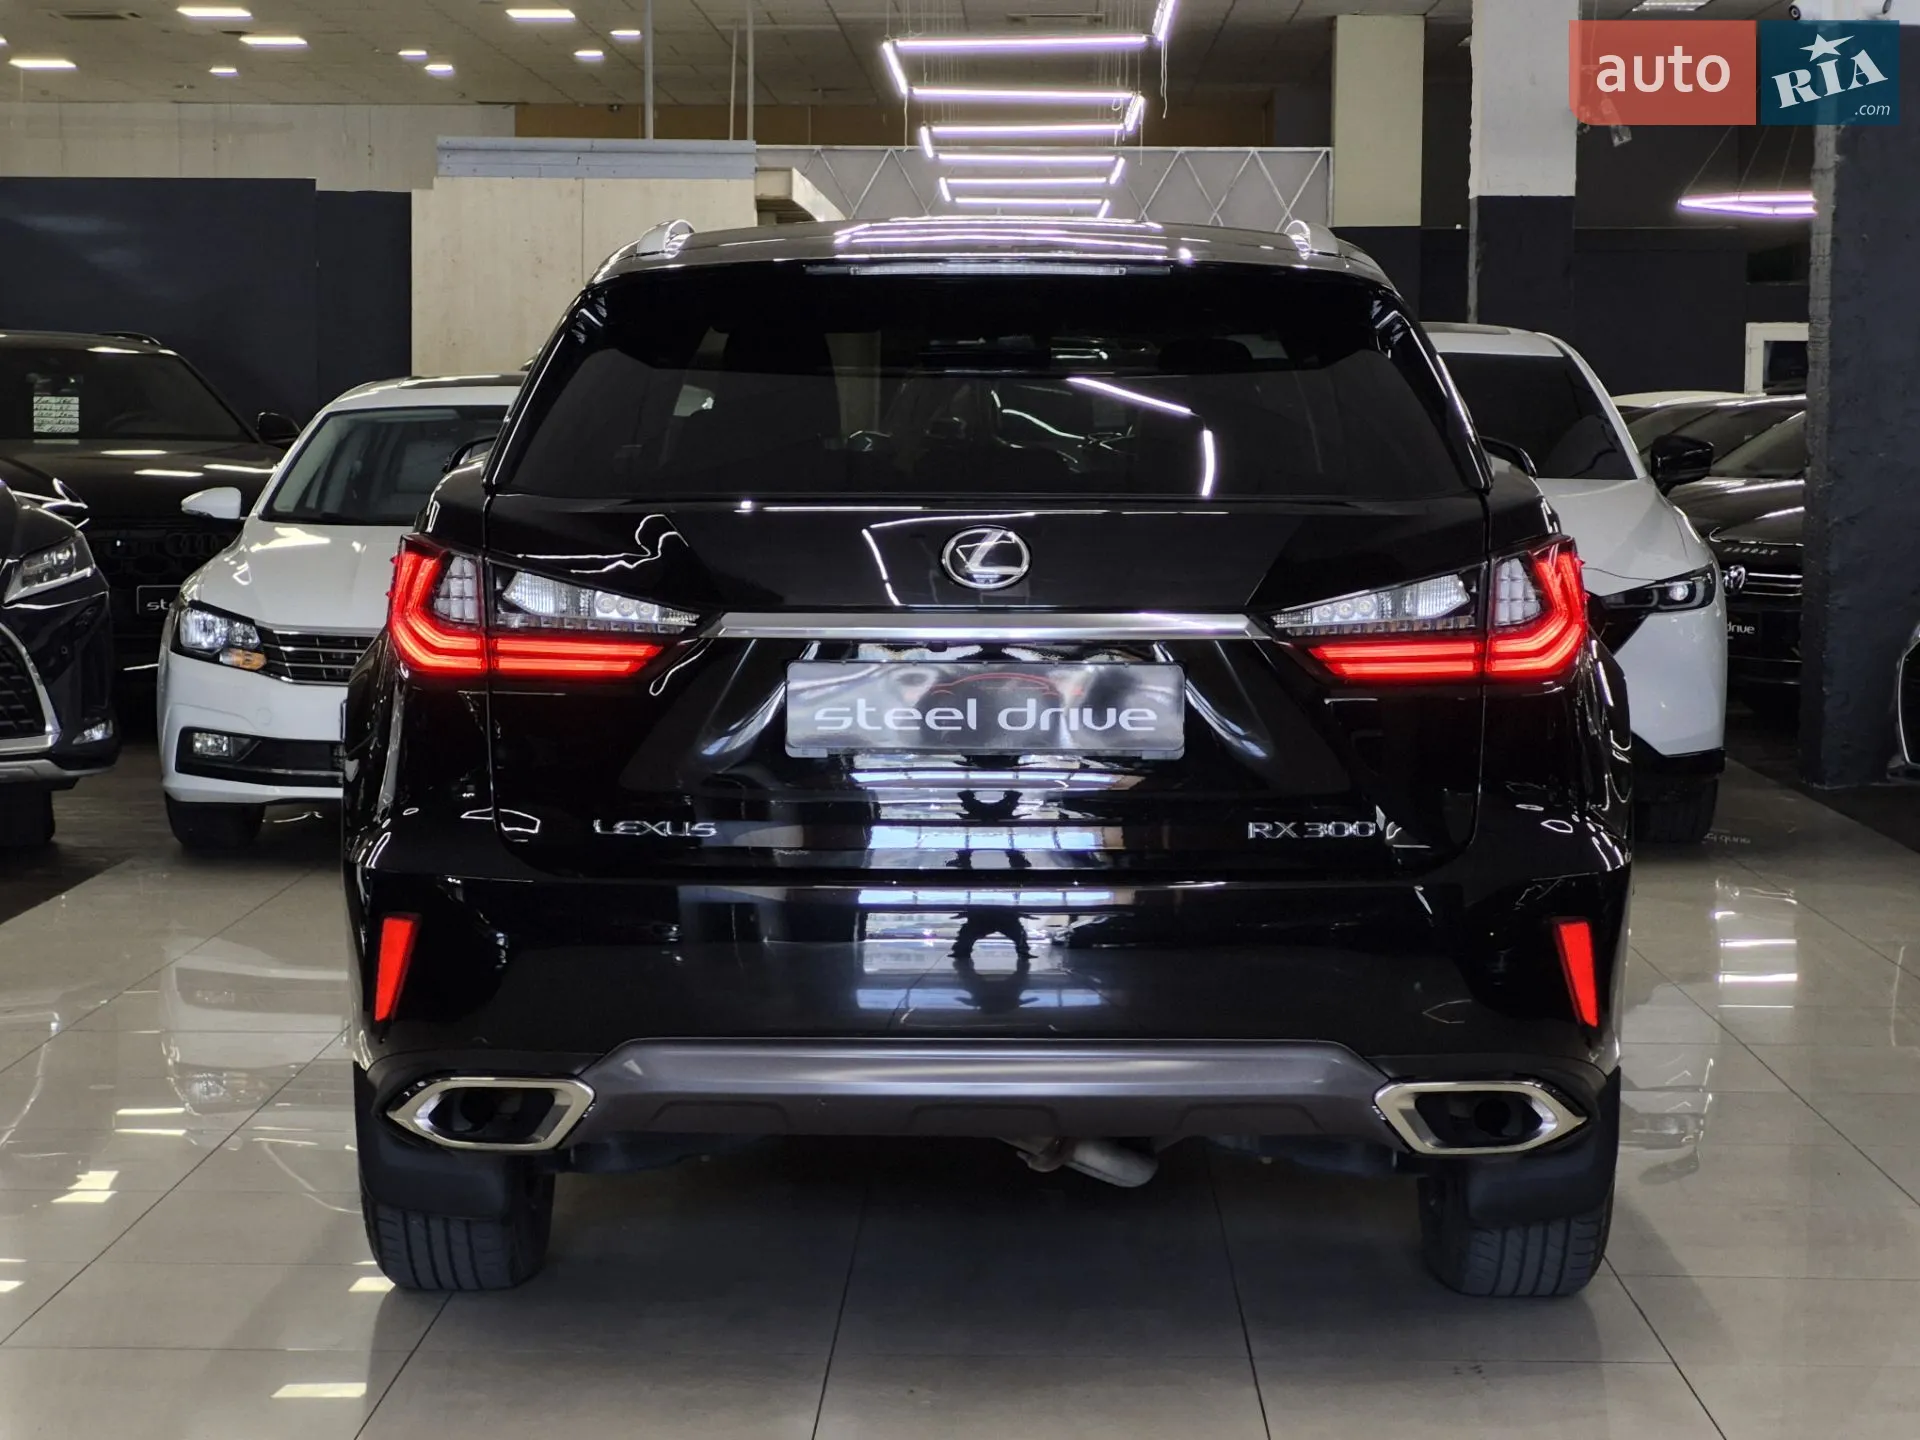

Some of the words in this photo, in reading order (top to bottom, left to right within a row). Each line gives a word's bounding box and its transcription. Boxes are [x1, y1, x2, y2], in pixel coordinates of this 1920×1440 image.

[814, 697, 977, 731] steel
[997, 697, 1158, 731] drive
[593, 818, 718, 838] LEXUS
[1247, 821, 1300, 839] RX
[1303, 820, 1376, 838] 300
